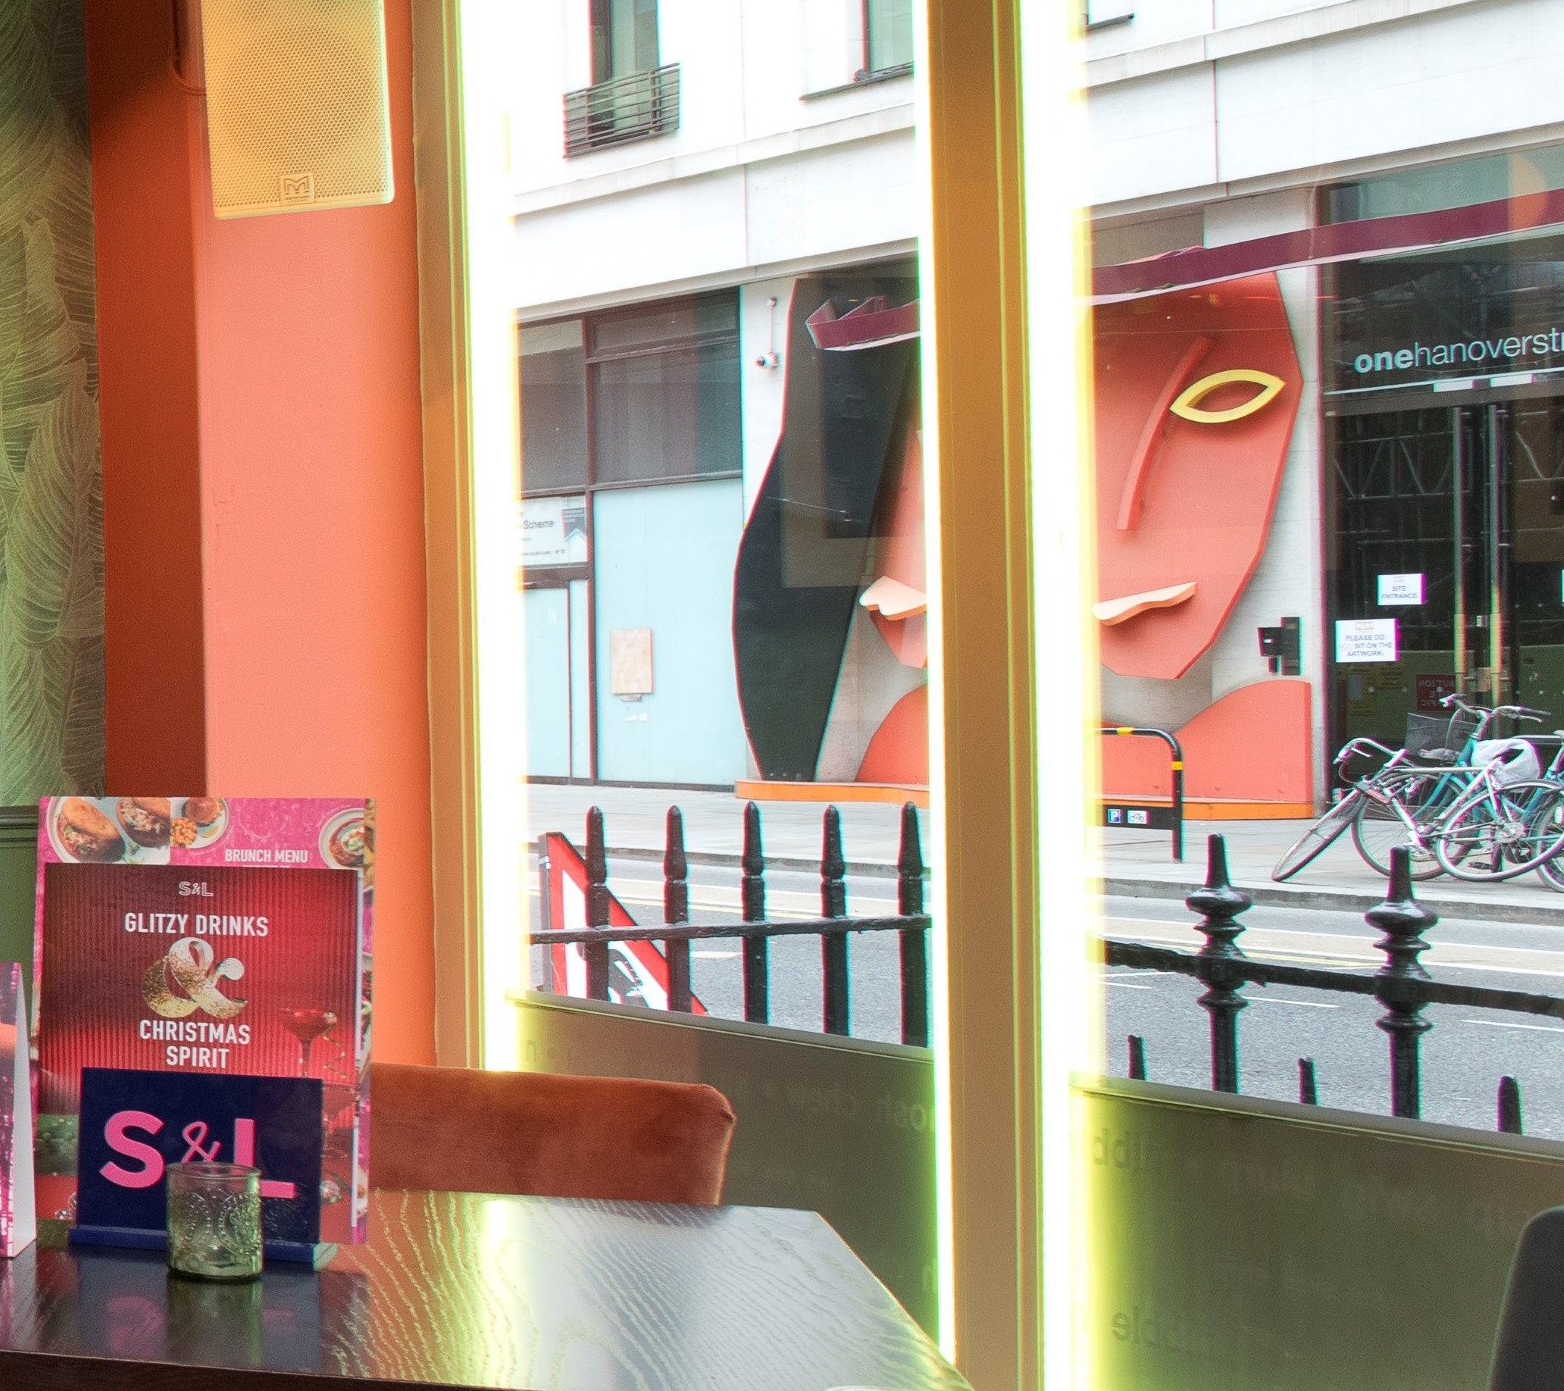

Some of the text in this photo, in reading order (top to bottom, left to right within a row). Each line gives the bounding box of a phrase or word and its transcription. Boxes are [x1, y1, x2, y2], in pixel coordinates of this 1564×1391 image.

[1381, 592, 1419, 600] ENTRANCE
[1391, 585, 1407, 593] SITE
[1345, 634, 1371, 642] PLEASE
[1354, 642, 1363, 650] SIT
[1379, 641, 1393, 649] THE
[224, 848, 309, 863] BRUNCH MENU
[178, 880, 214, 898] S&L
[123, 912, 269, 938] GLITZY DRINKS
[139, 1019, 251, 1046] CHRISTMAS
[165, 1045, 230, 1069] SPIRIT
[98, 1109, 297, 1201] S&L
